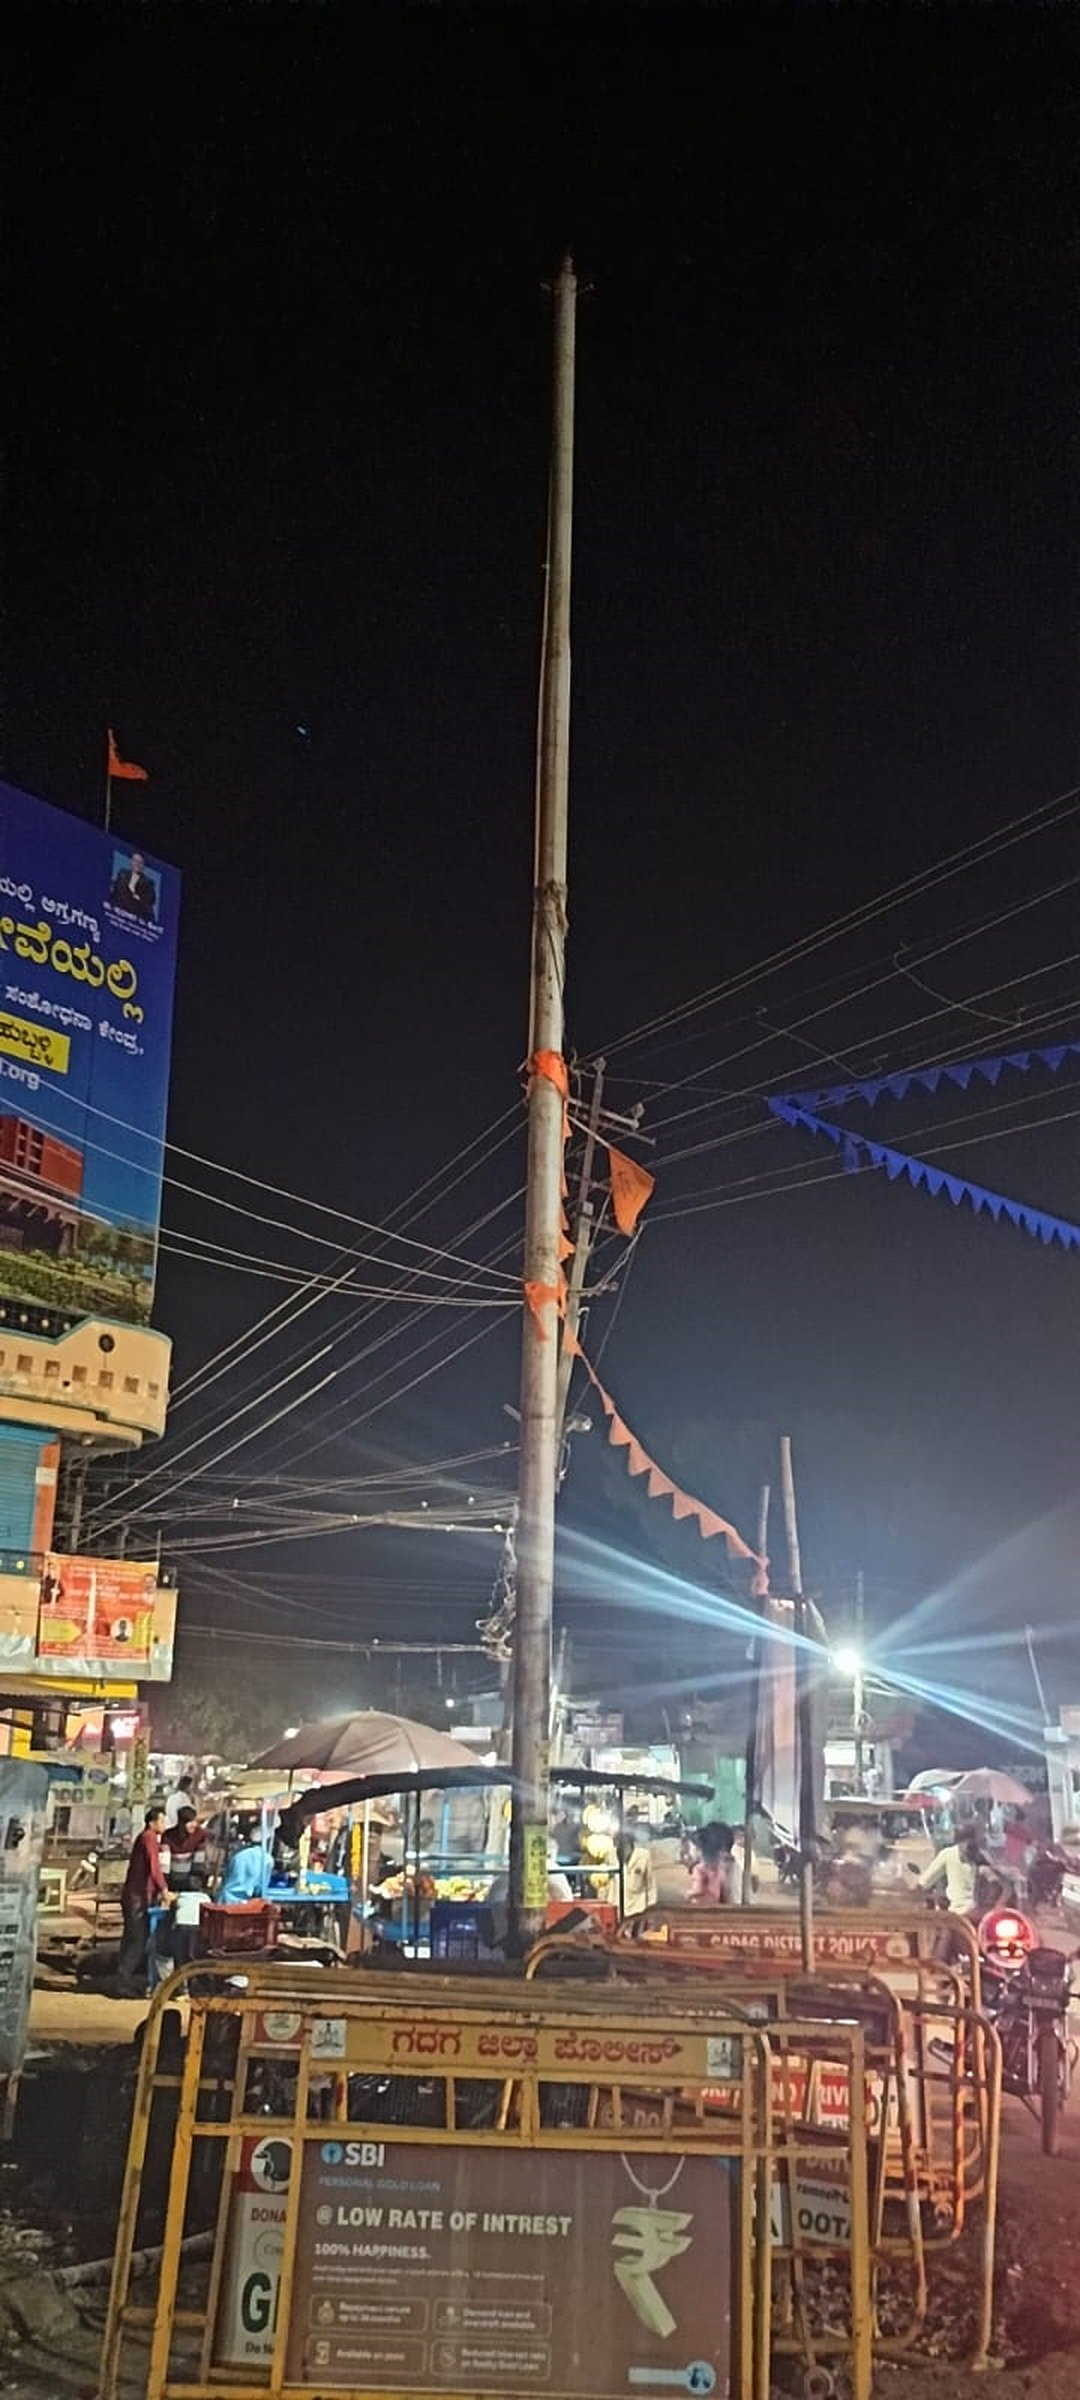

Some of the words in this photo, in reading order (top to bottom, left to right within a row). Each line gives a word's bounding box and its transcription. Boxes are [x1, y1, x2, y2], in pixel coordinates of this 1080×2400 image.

[391, 2027, 462, 2055] ಗದಗ
[477, 2034, 538, 2064] ಜಿಲ್ಲಾ
[345, 2143, 385, 2167] SBI
[377, 2179, 408, 2191] GOLD
[316, 2205, 332, 2225] @
[337, 2206, 383, 2226] LOW
[388, 2209, 443, 2230] RATE
[450, 2211, 477, 2231] OF
[483, 2213, 572, 2236] INTREST
[315, 2243, 350, 2256] 100%
